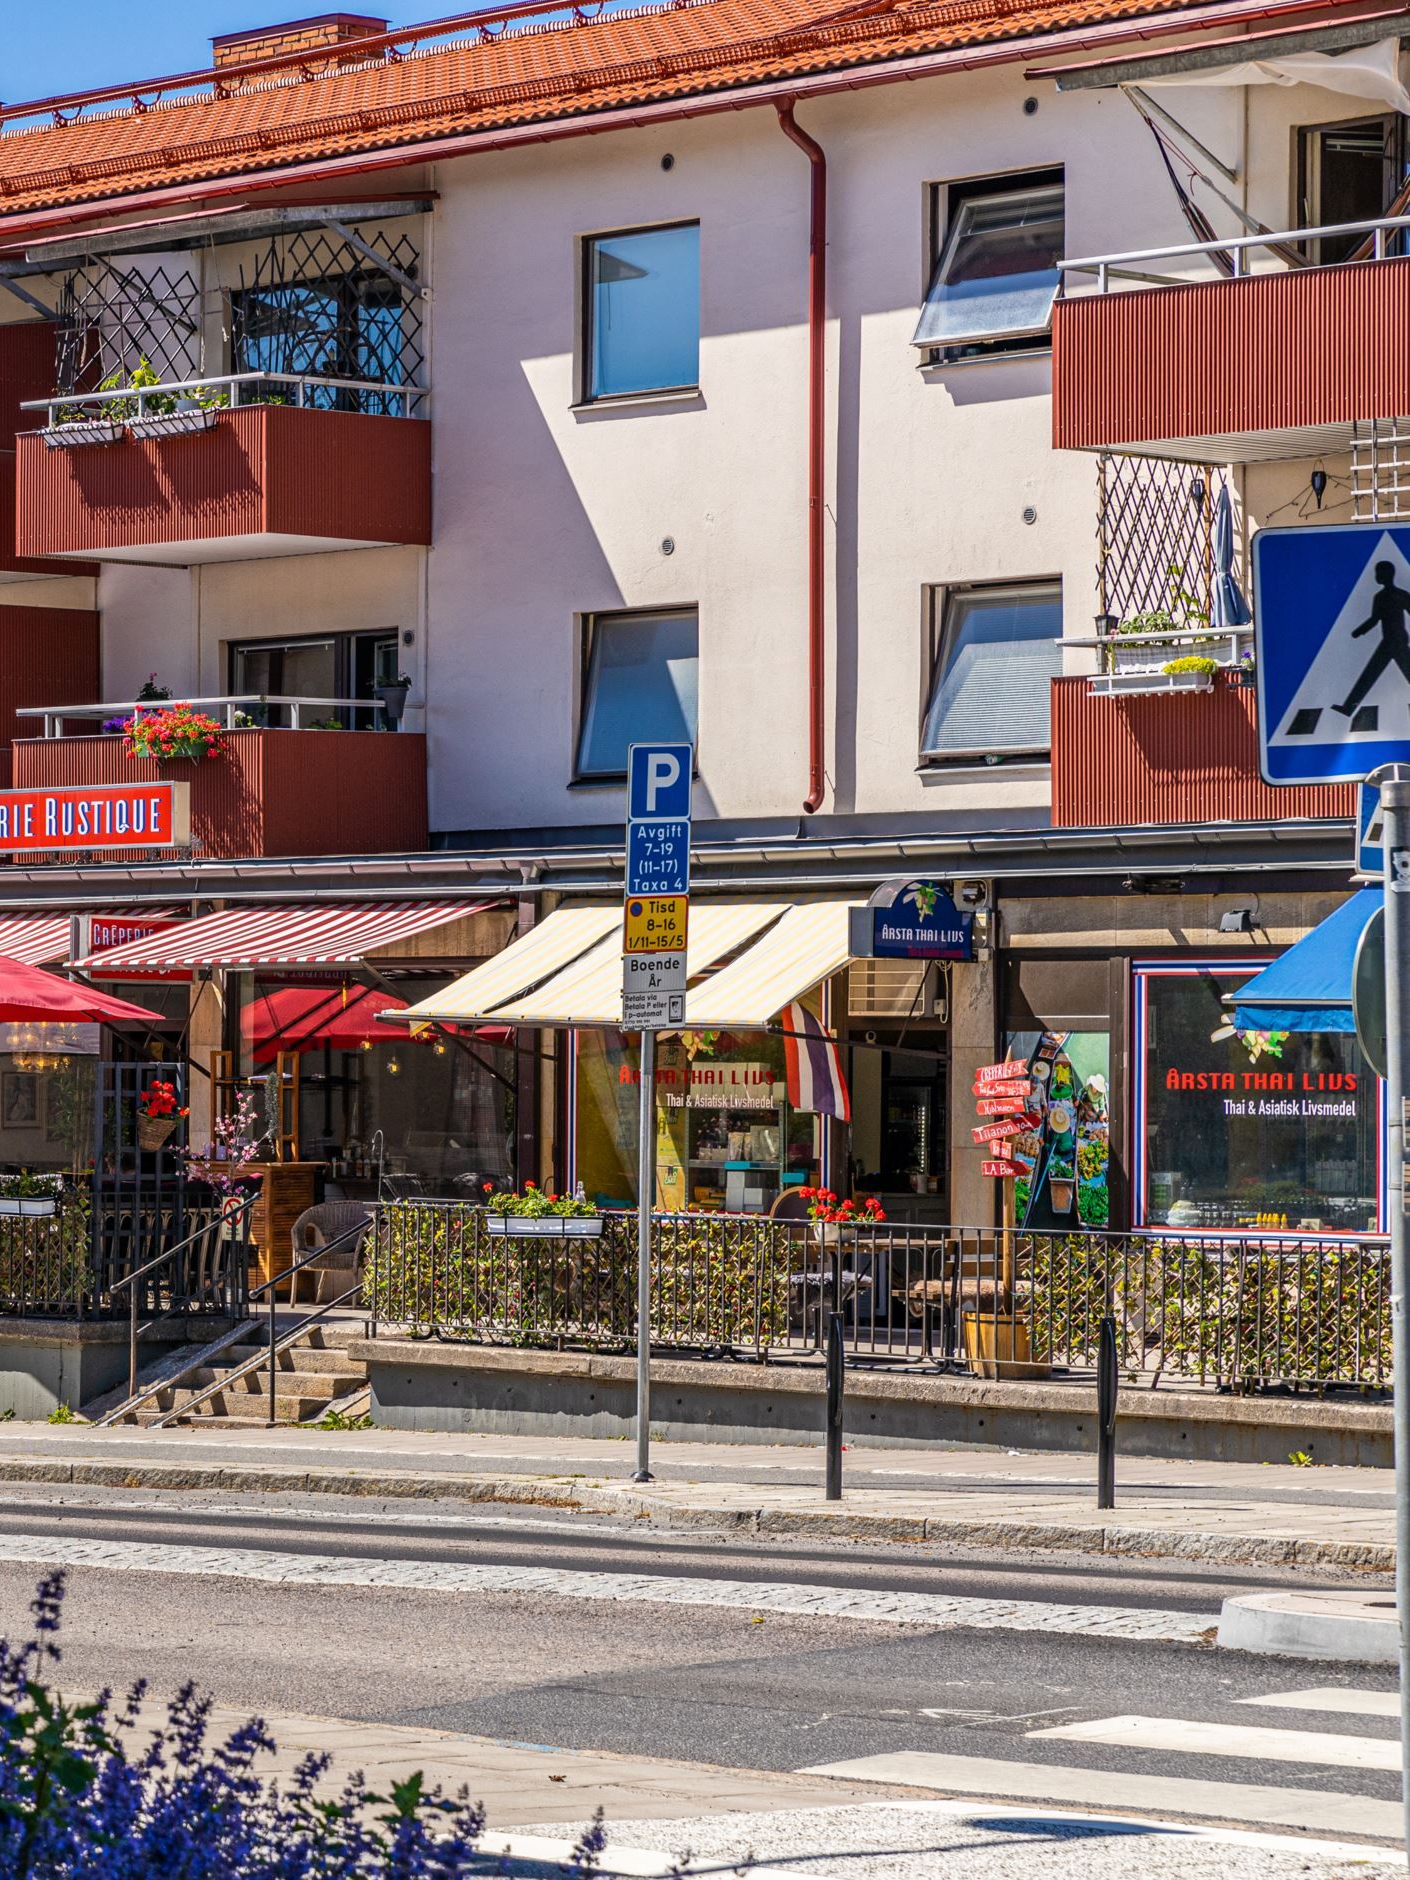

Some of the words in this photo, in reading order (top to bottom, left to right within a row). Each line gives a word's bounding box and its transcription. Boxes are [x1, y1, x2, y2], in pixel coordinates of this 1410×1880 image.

[646, 753, 680, 811] P
[45, 798, 161, 837] RUSTIQUE
[637, 825, 682, 841] Avgift
[644, 843, 674, 856] 7-19
[639, 859, 678, 875] (11-17)
[633, 879, 668, 892] Taxa
[674, 878, 683, 890] 4
[649, 901, 676, 914] Tisd
[646, 918, 676, 931] 8-16
[882, 924, 912, 940] ÅRSTA
[915, 929, 938, 942] THAI
[628, 935, 684, 948] 1/11-15/5
[631, 958, 680, 972] Boende
[648, 973, 662, 988] År
[625, 994, 645, 1002] Betala
[619, 1065, 676, 1085] ÅRTA
[681, 1069, 723, 1085] THAI
[1166, 1067, 1235, 1090] ÅRSTA
[1241, 1072, 1294, 1090] THAI
[666, 1093, 684, 1107] Thai
[686, 1094, 692, 1107] &
[695, 1094, 728, 1108] Asiatisk
[730, 1095, 774, 1109] Livsmedel
[1224, 1099, 1245, 1115] Thai
[1248, 1101, 1256, 1115] &
[1258, 1100, 1299, 1116] Asiatisk
[1302, 1100, 1356, 1116] Livsmedel
